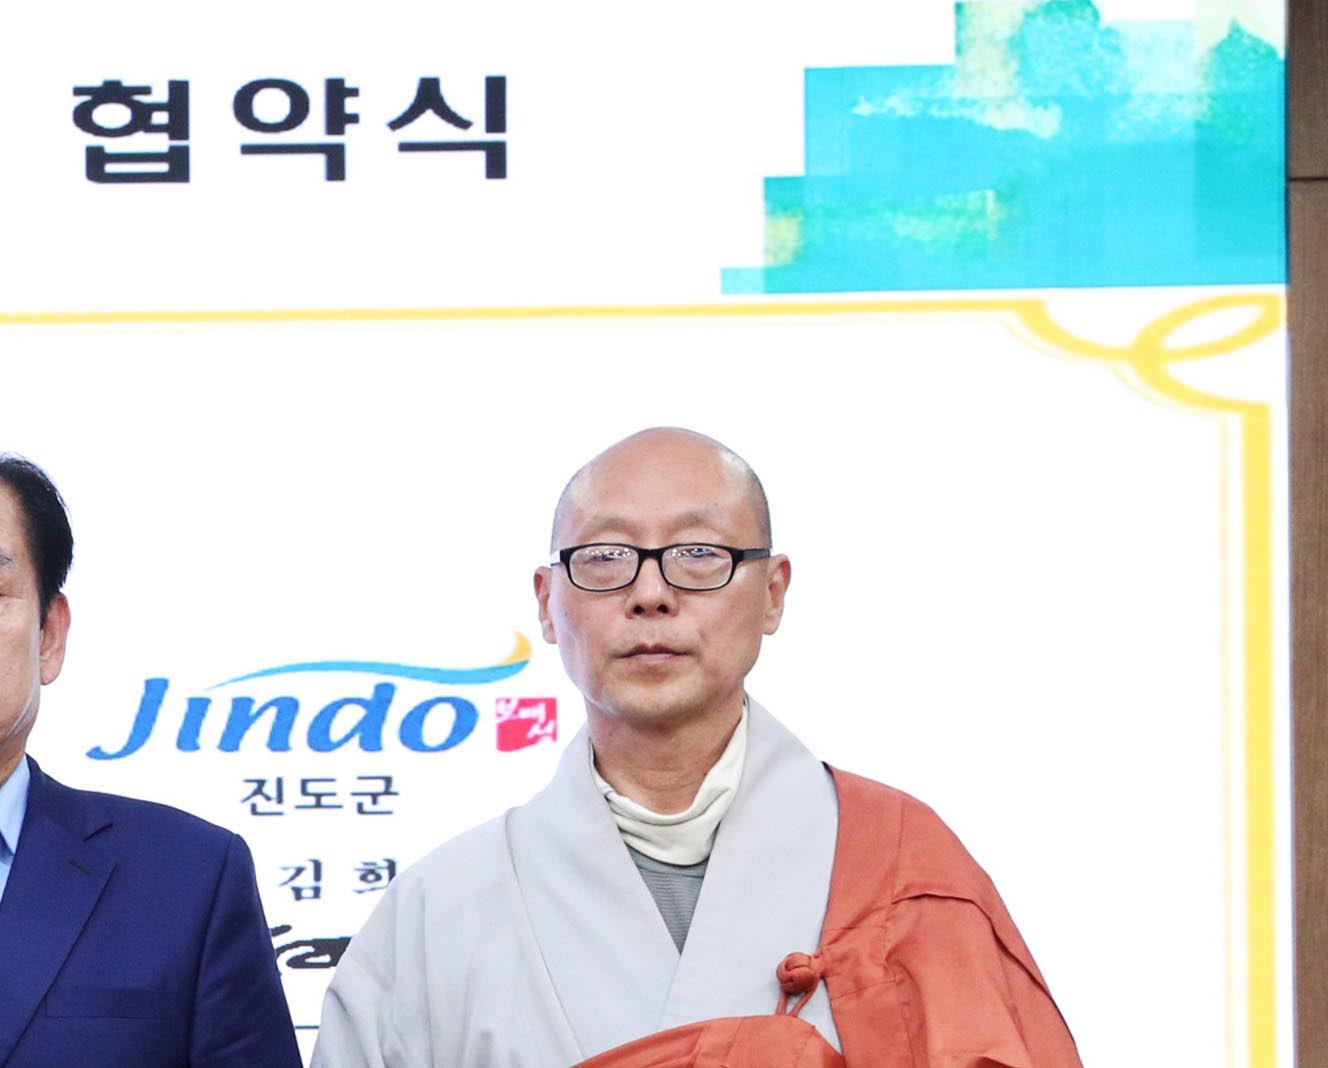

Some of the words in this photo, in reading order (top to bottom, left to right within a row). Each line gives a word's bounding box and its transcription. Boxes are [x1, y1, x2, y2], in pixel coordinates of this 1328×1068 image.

[72, 75, 507, 184] 협약식
[86, 678, 478, 760] Jindo
[241, 775, 400, 817] 진도군
[278, 858, 397, 901] 김희
